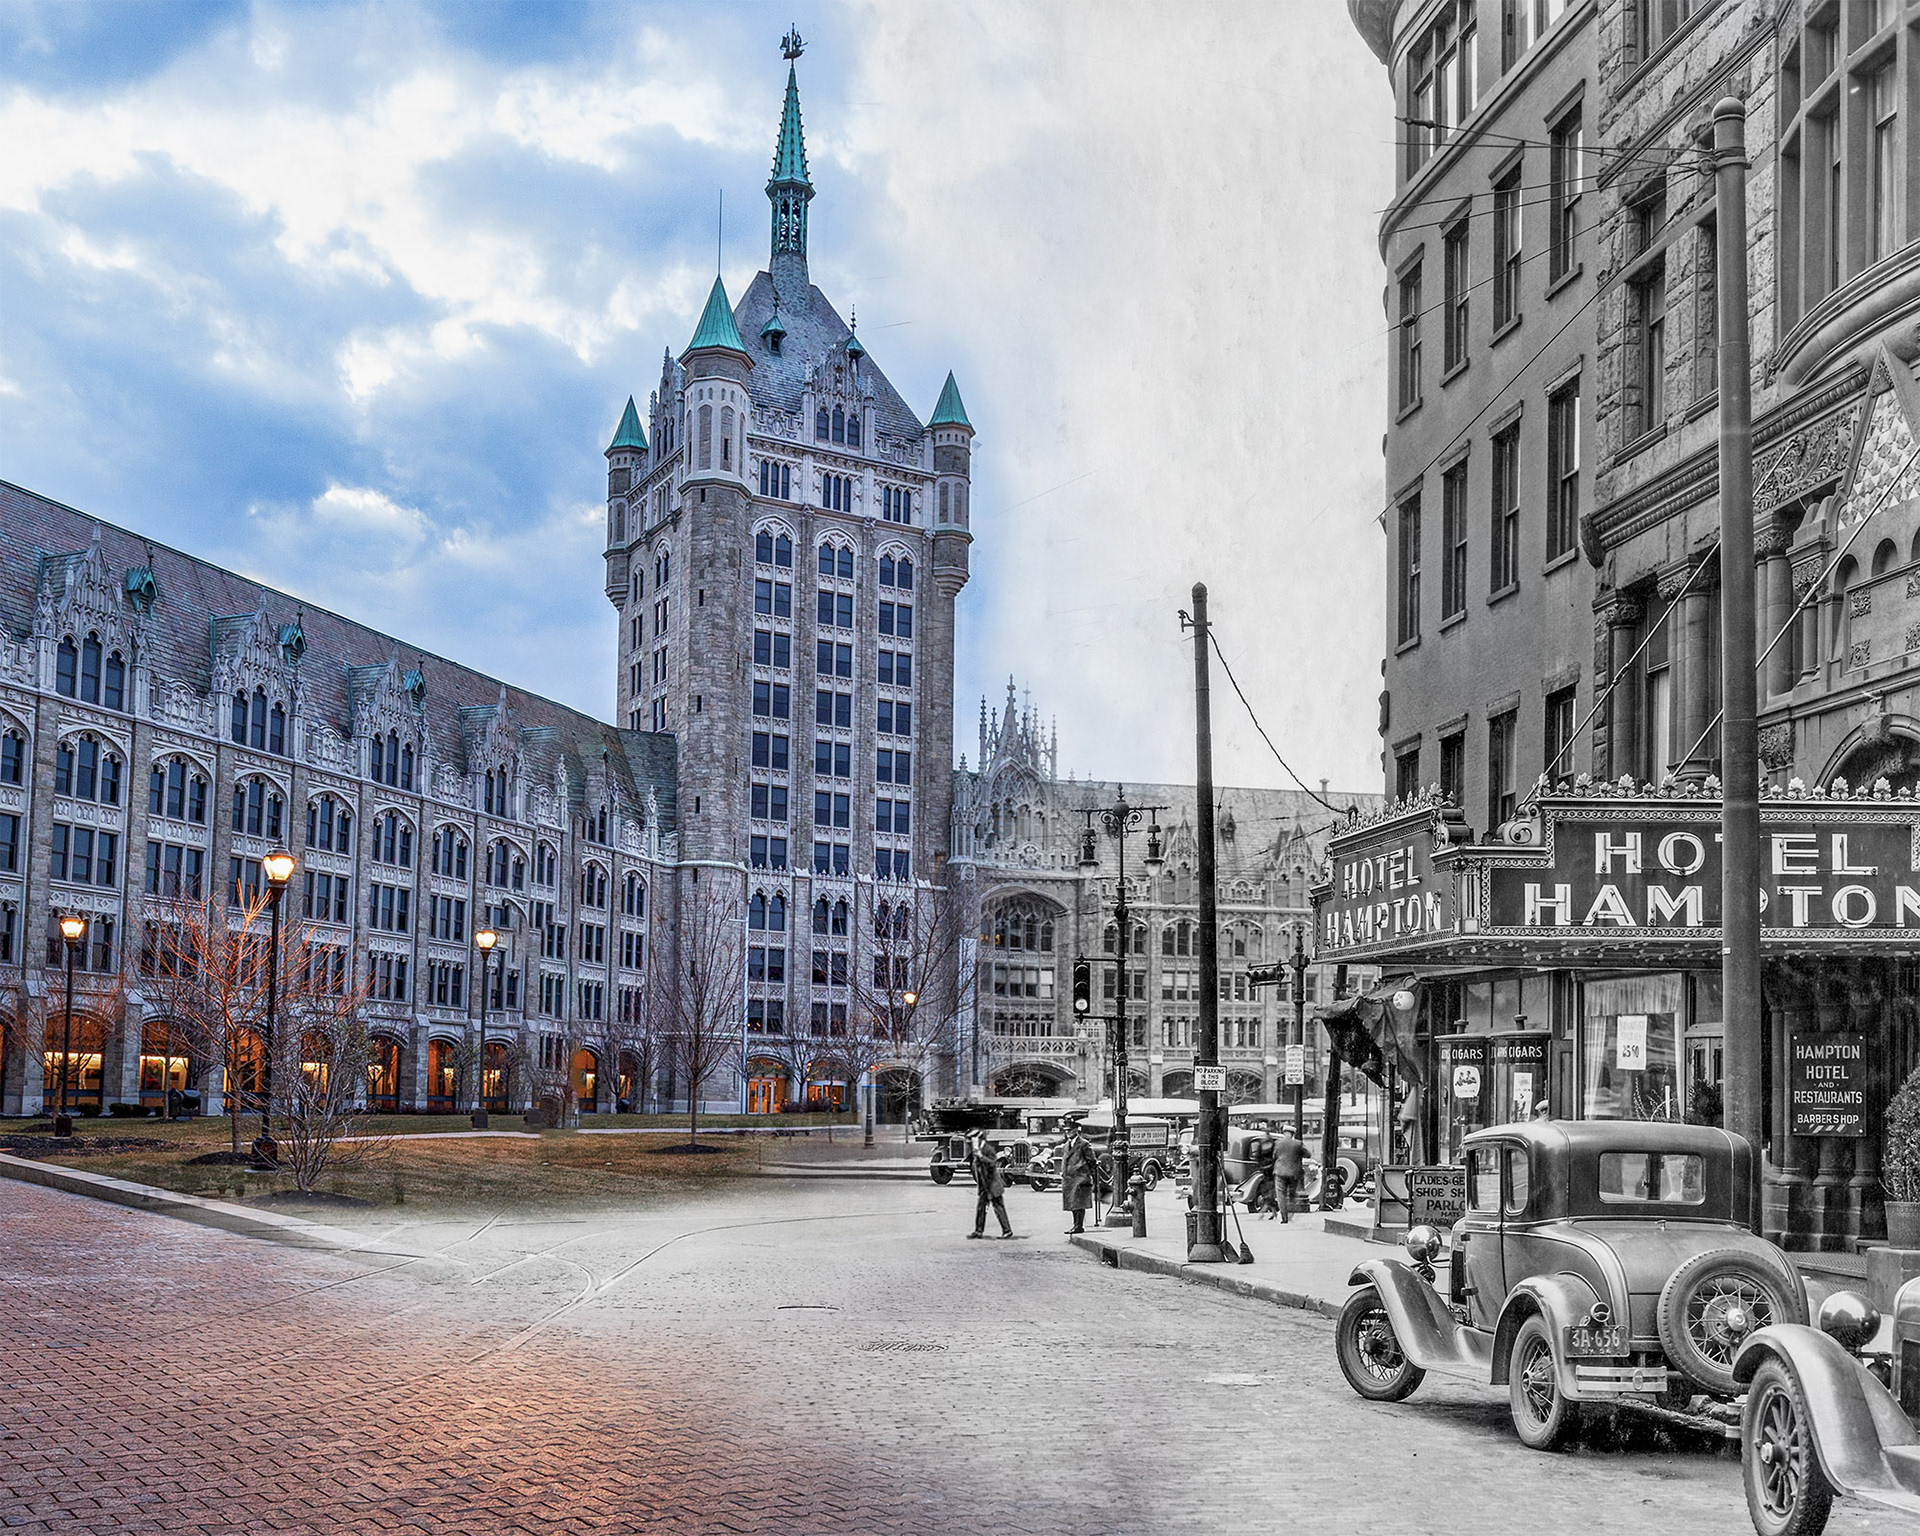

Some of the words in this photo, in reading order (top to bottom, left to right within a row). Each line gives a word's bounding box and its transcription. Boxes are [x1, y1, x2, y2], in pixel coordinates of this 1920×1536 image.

[1595, 831, 1879, 876] HOEL
[1342, 846, 1421, 900] HOTEL
[1324, 891, 1442, 949] HAMPTON
[1452, 1049, 1483, 1060] CIGARS
[1508, 1046, 1543, 1058] CIGARS
[1796, 1045, 1860, 1059] HAMPTON
[1806, 1065, 1849, 1079] HOTEL
[1794, 1091, 1863, 1104] RESTAURANTS
[1415, 1176, 1449, 1185] LADIES
[1416, 1187, 1445, 1197] SHOE
